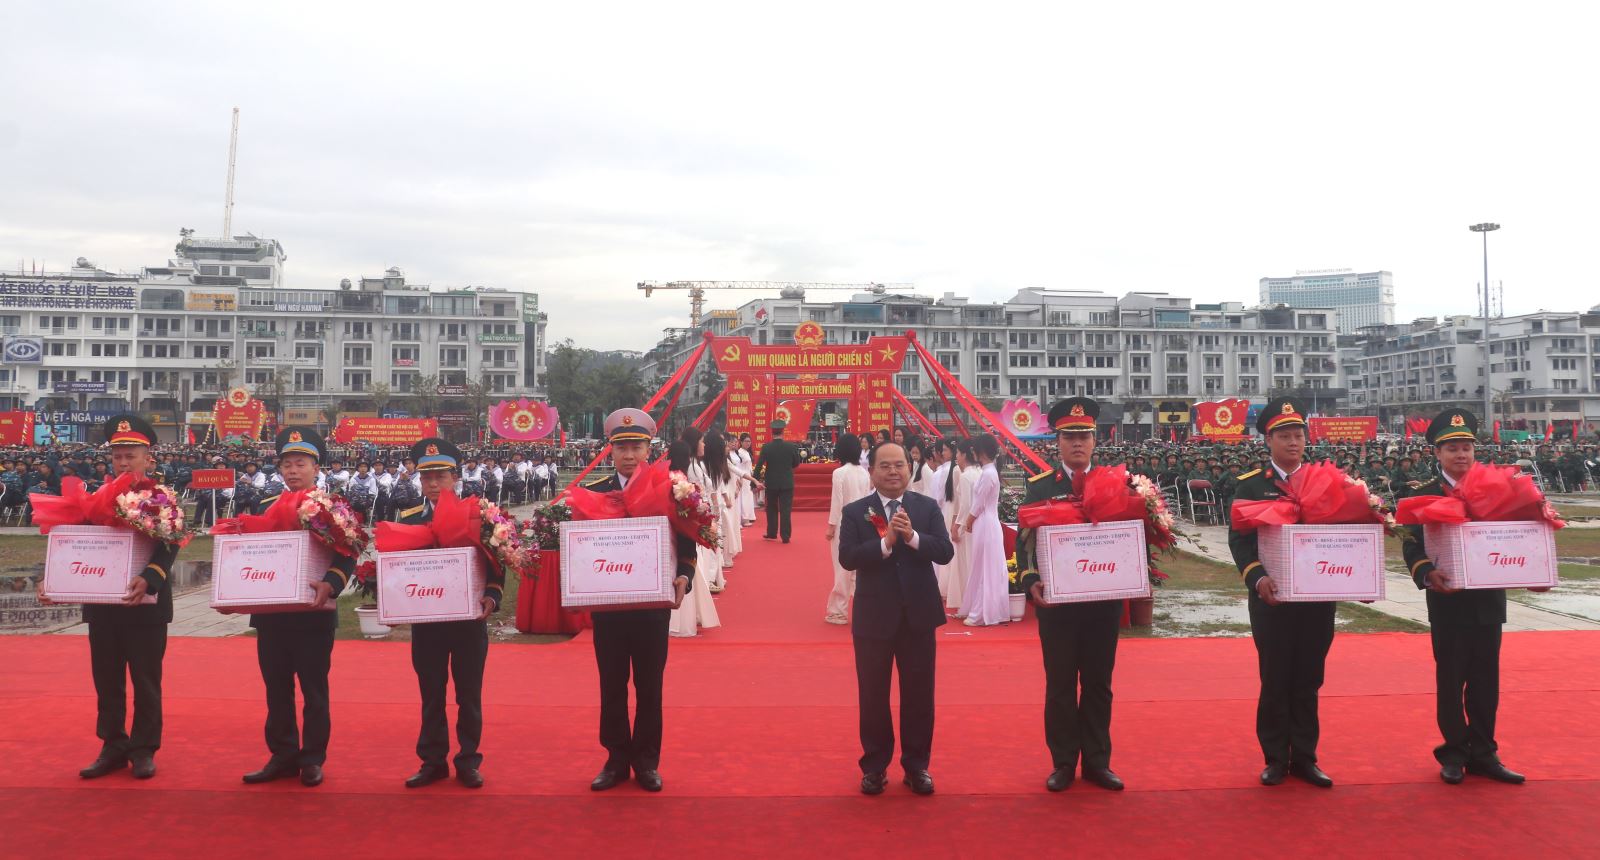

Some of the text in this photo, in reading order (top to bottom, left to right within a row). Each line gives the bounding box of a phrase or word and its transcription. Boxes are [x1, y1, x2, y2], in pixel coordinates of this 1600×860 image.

[107, 286, 134, 297] NGA
[92, 299, 134, 310] HOSPITAL
[748, 349, 872, 368] VINH QUANG LÀ NGƯỜI CHIẾN SĨ
[781, 383, 799, 395] BƯỚC
[829, 383, 852, 395] THỐNG
[71, 412, 92, 423] NGA
[592, 558, 633, 575] Tặng
[1076, 559, 1116, 575] Tặng
[1487, 552, 1526, 568] Tặng
[70, 561, 106, 578] Tặng
[240, 566, 276, 582] Tặng
[1315, 560, 1353, 577] Tặng
[404, 583, 444, 599] Tặng
